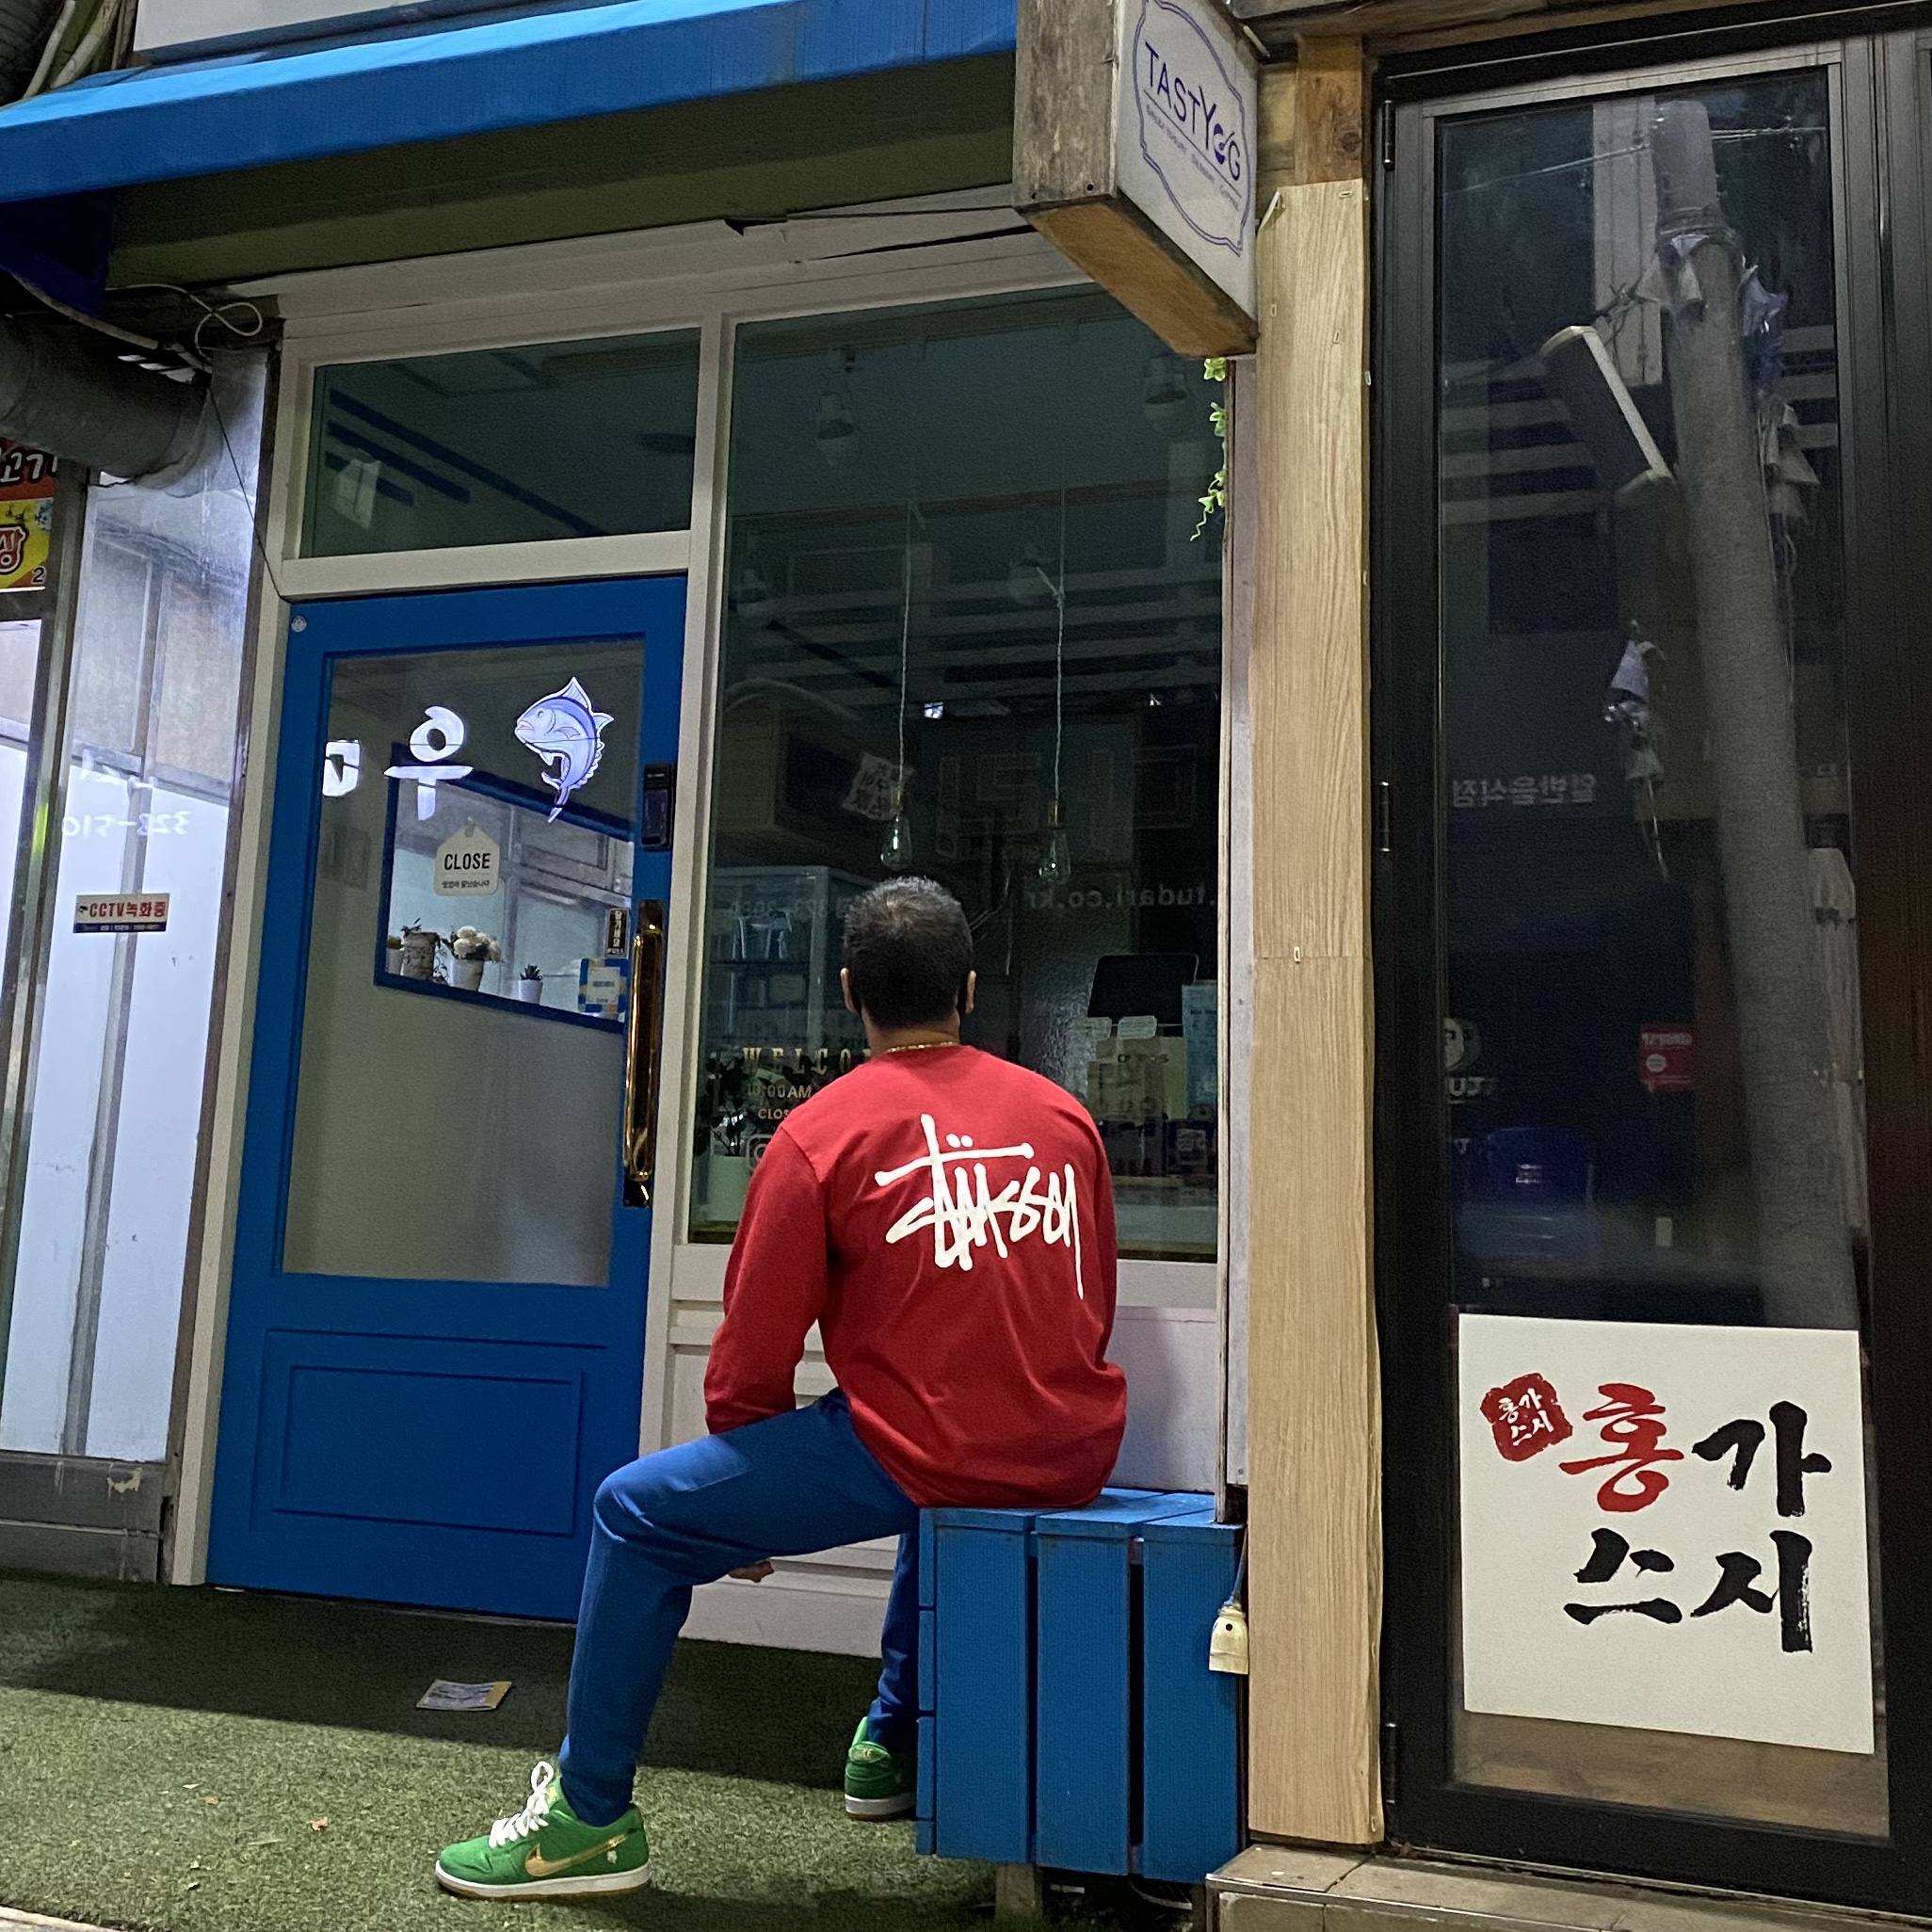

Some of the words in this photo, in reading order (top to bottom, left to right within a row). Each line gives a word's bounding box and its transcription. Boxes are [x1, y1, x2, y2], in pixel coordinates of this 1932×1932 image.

[32, 566, 45, 584] 2
[444, 852, 491, 871] CLOSE
[89, 900, 167, 918] CCTV녹화중
[742, 1047, 871, 1076] WELCO
[1497, 1387, 1543, 1423] 홍가
[1509, 1409, 1554, 1445] 스시
[1559, 1382, 1832, 1518] 홍가
[1563, 1528, 1814, 1653] 스시
